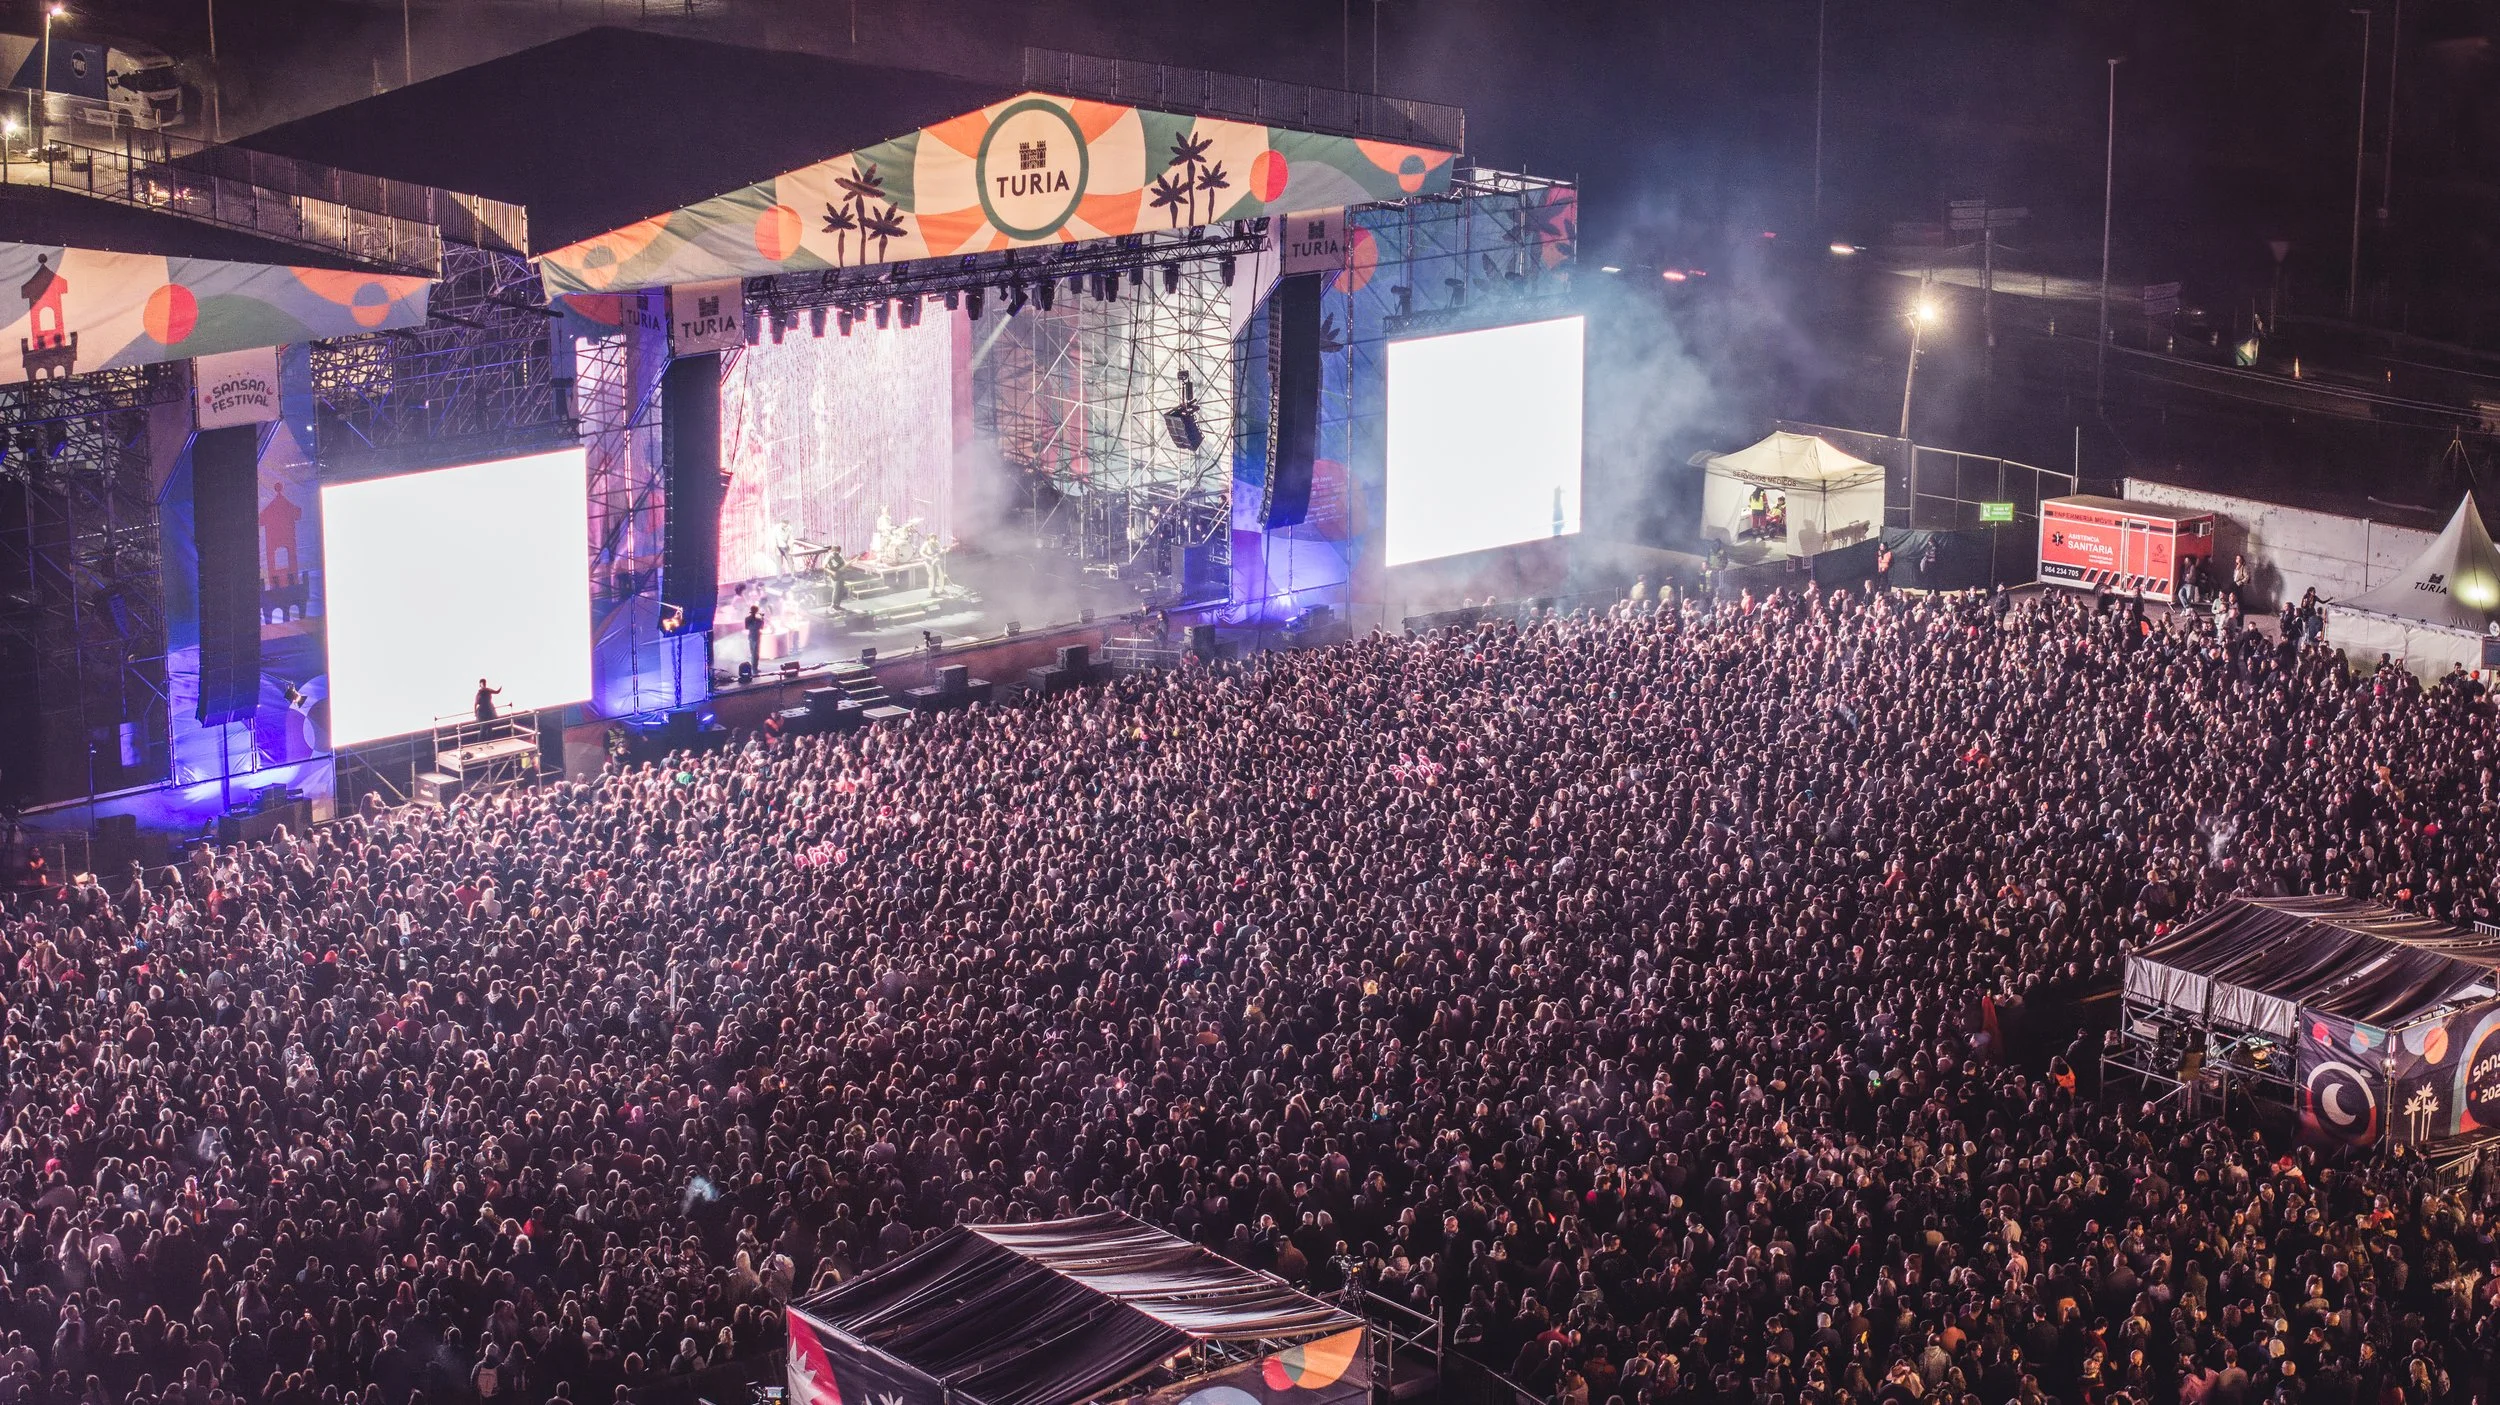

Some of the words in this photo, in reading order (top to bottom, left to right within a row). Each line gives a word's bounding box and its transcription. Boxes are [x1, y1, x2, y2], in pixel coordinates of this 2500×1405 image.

[996, 170, 1070, 198] TURIA
[1292, 240, 1339, 258] TURIA
[627, 308, 660, 331] TURIA
[681, 315, 737, 338] TURIA
[212, 379, 266, 399] SANSAN
[211, 394, 269, 413] FESTIVAL
[1733, 471, 1767, 482] SERVICIOS
[2068, 534, 2100, 543] ASISTENCIA
[2068, 540, 2113, 555] SANITARIA
[2068, 569, 2079, 577] 705
[2414, 581, 2448, 595] TURIA
